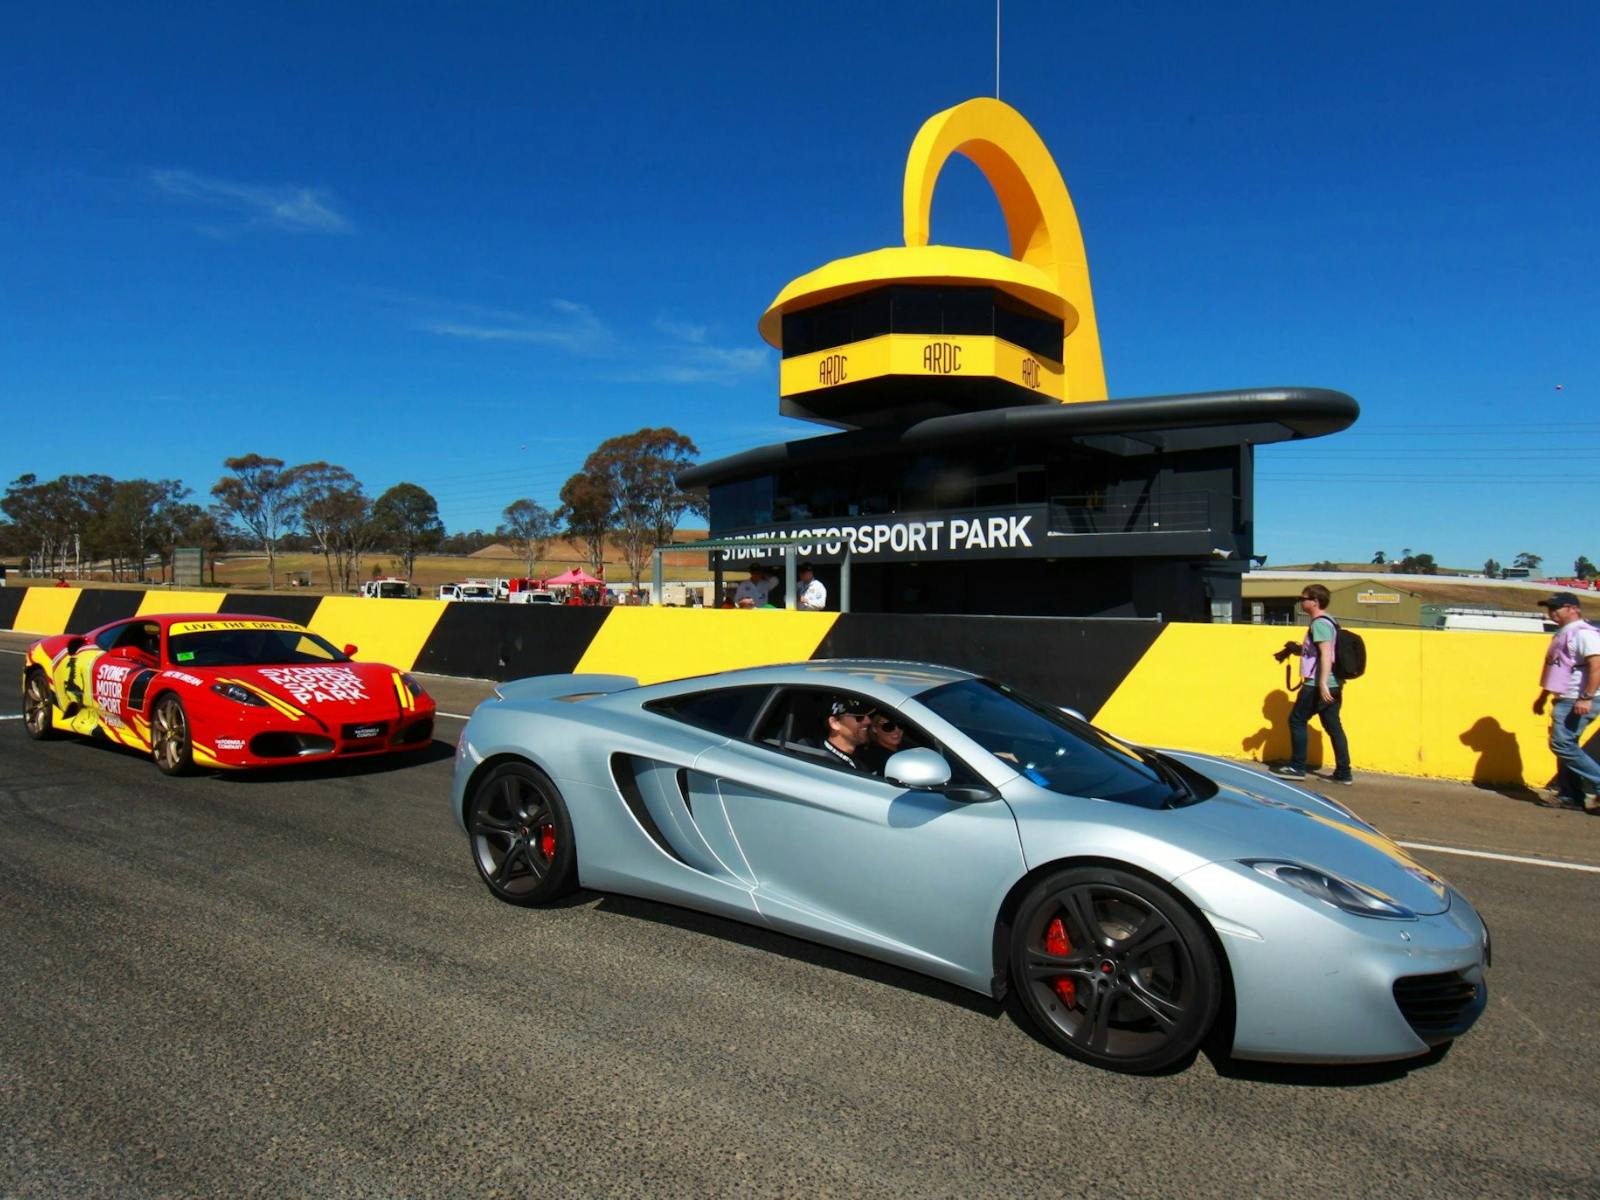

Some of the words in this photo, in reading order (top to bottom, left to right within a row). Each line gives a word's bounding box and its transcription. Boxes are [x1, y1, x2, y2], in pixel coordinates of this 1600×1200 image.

[923, 342, 962, 374] ARDC
[819, 354, 848, 385] ARDC
[1022, 358, 1041, 388] ARDC
[721, 531, 776, 561] SYDNEY
[780, 521, 945, 557] MOTORSPORT
[949, 515, 1033, 550] PARK
[183, 623, 218, 631] LIVE
[221, 621, 247, 629] THE
[252, 622, 303, 631] DREAM
[97, 664, 131, 683] SYDNEY
[258, 667, 353, 677] SYDNEY
[270, 674, 363, 684] MOTOR
[96, 680, 122, 699] MOTOR
[284, 681, 366, 693] SPORT
[293, 689, 370, 704] PARK
[97, 695, 121, 715] SPORT
